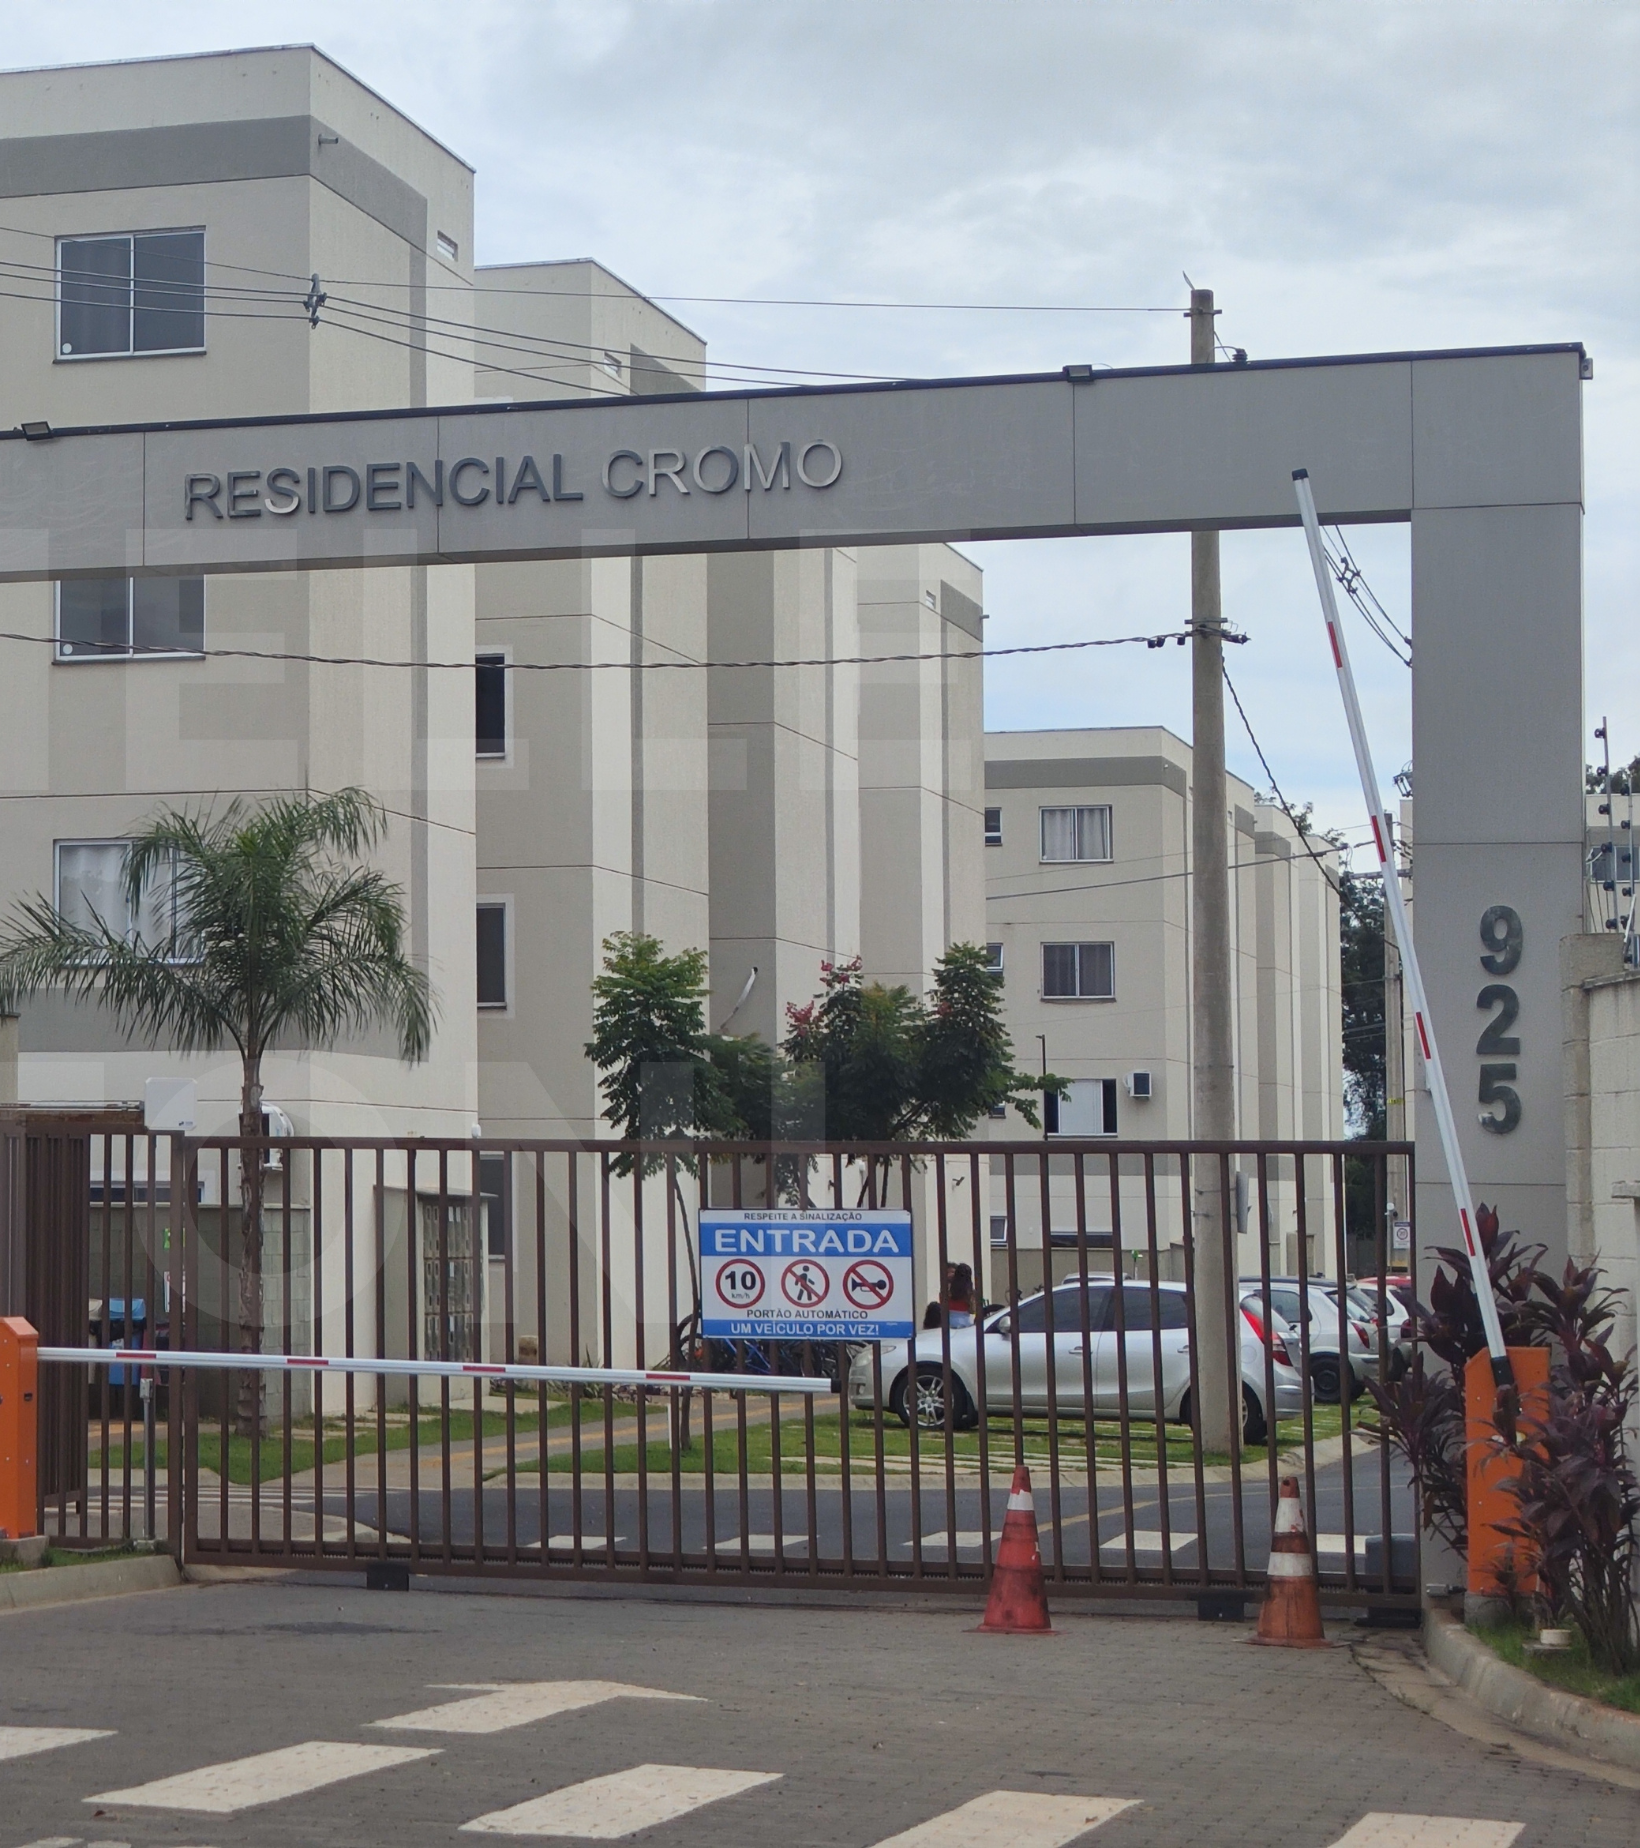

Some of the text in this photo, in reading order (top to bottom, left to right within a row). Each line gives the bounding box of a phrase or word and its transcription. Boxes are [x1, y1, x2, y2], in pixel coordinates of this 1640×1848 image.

[184, 439, 844, 520] RESIDENCIAL CROMO
[1476, 905, 1524, 1135] 925
[744, 1212, 862, 1222] RESPEITE A SINALIZAÇÃO
[714, 1229, 900, 1253] ENTRADA
[724, 1271, 757, 1291] 10
[731, 1292, 751, 1300] km/h
[746, 1308, 868, 1320] PORTÃO AUTOMÁTICO
[730, 1320, 879, 1336] UM VEÍCULO POR VEZ!
